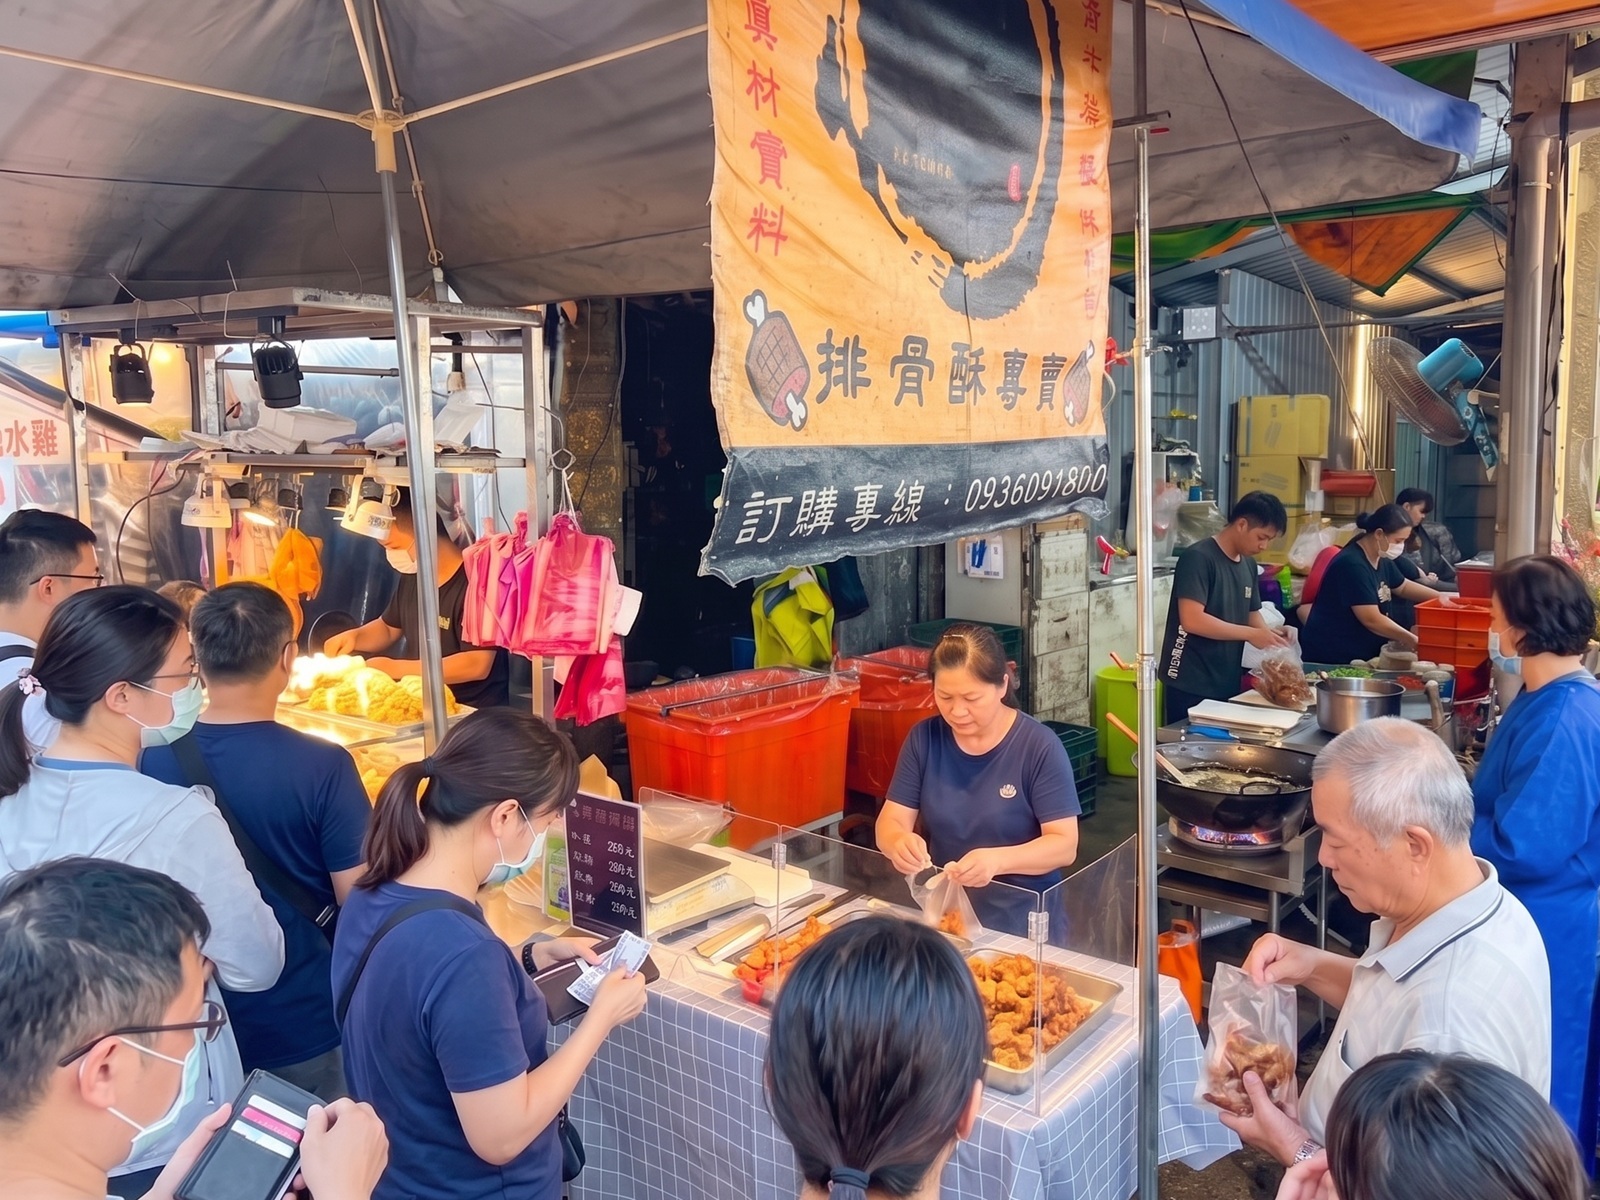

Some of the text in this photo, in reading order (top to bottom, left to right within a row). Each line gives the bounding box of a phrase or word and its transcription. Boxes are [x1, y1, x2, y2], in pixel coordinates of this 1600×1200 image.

[815, 328, 1068, 412] 排骨酥專賣
[0, 419, 59, 457] 水雞
